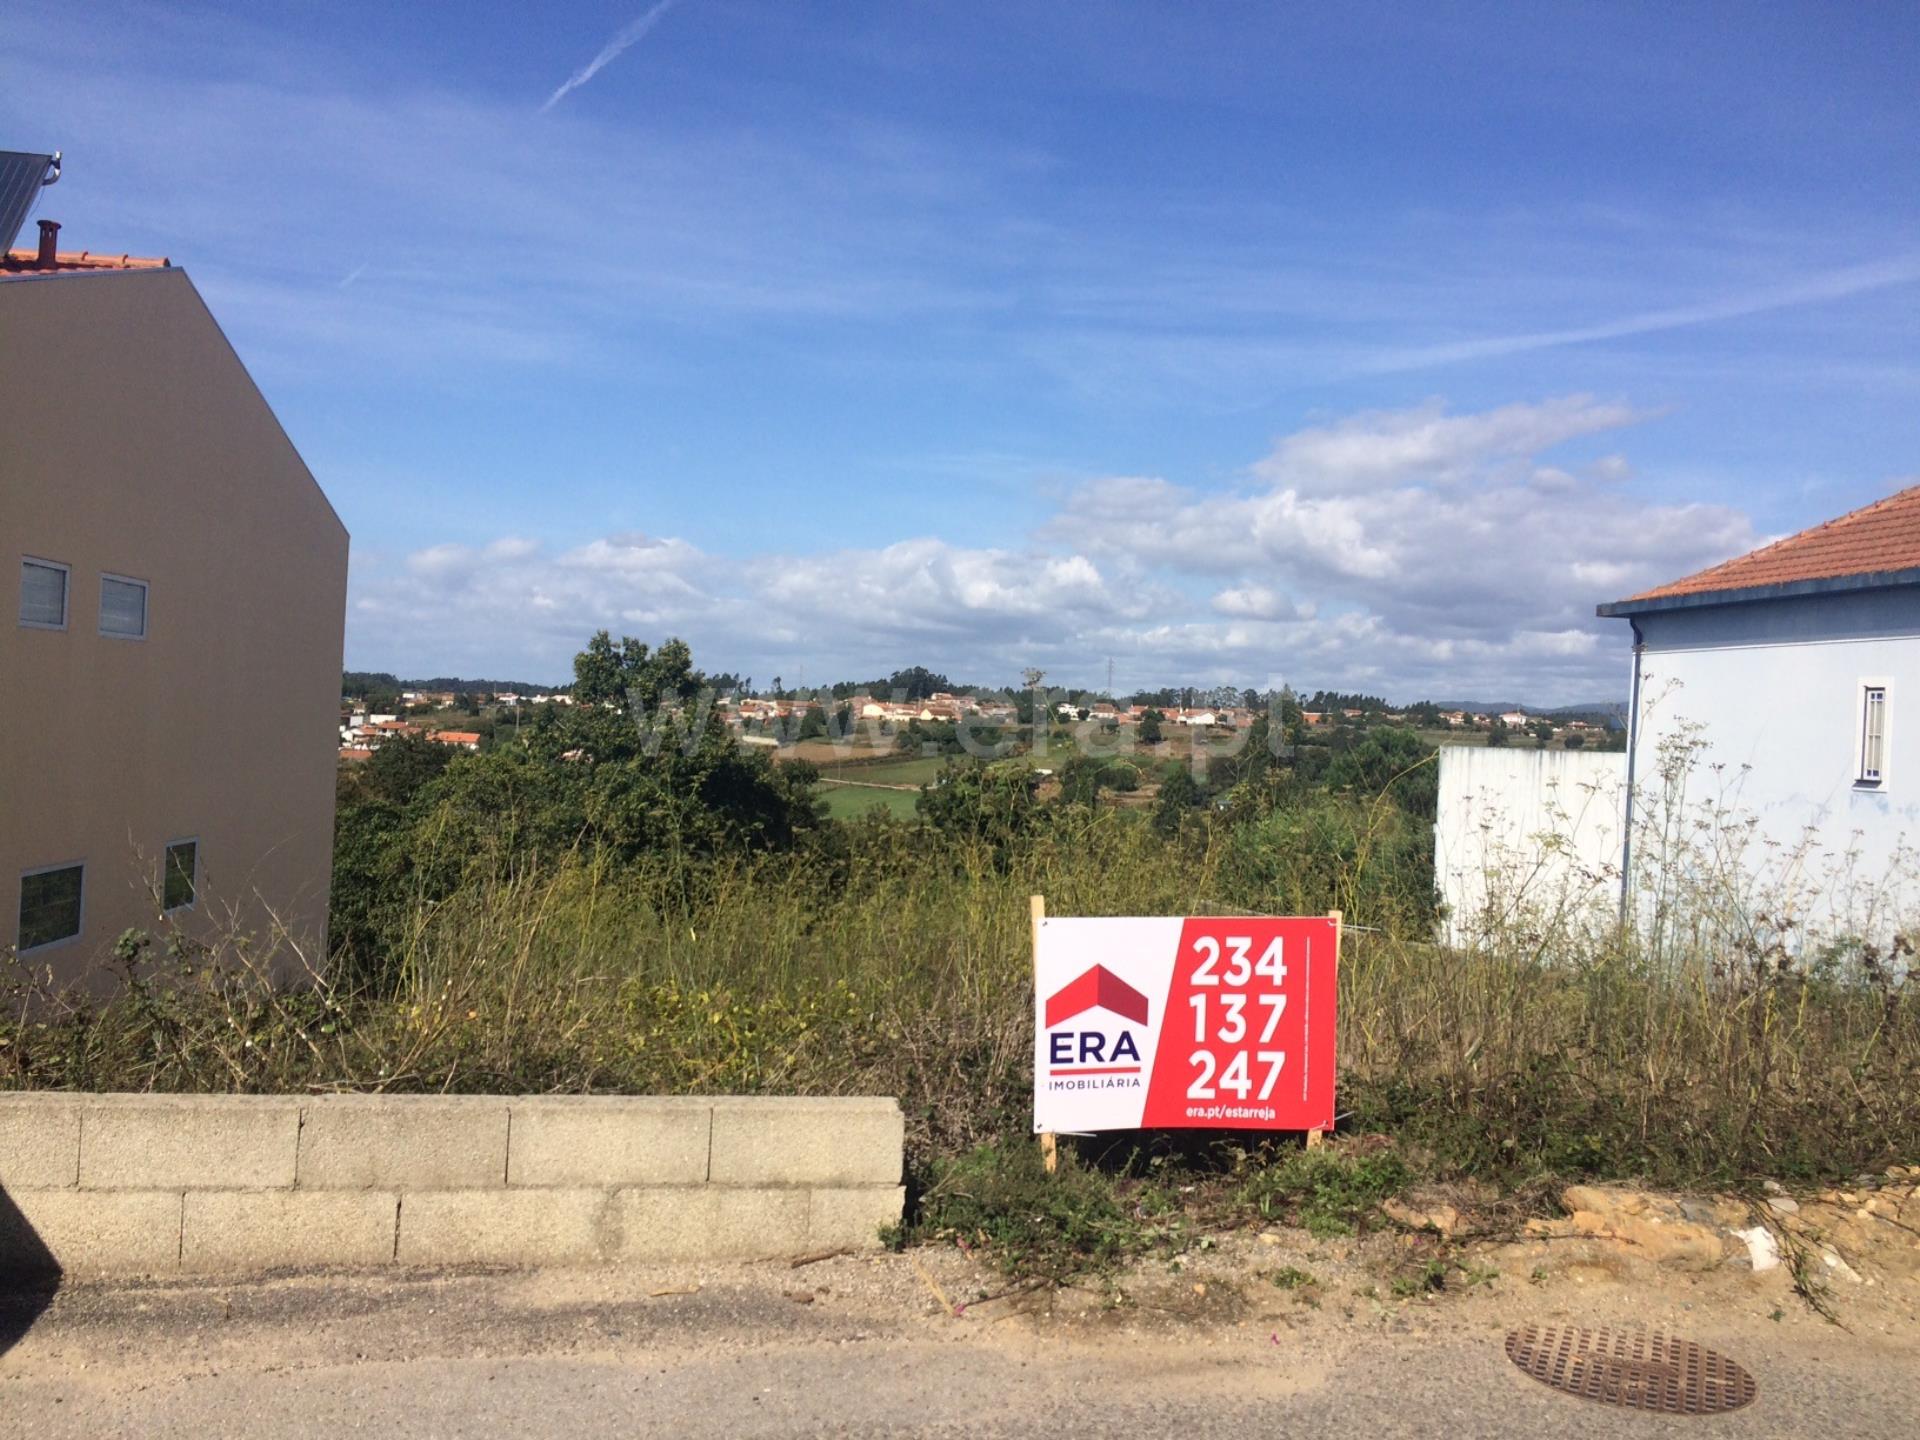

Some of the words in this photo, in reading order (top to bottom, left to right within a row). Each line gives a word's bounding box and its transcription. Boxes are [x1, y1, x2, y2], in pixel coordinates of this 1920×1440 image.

[1190, 936, 1287, 986] 234
[1190, 993, 1287, 1043] 137
[1050, 1031, 1141, 1064] ERA
[1049, 1076, 1141, 1091] IMOBILIÁRIA
[1186, 1050, 1286, 1101] 247
[1186, 1105, 1276, 1120] era.pt/estarreja
